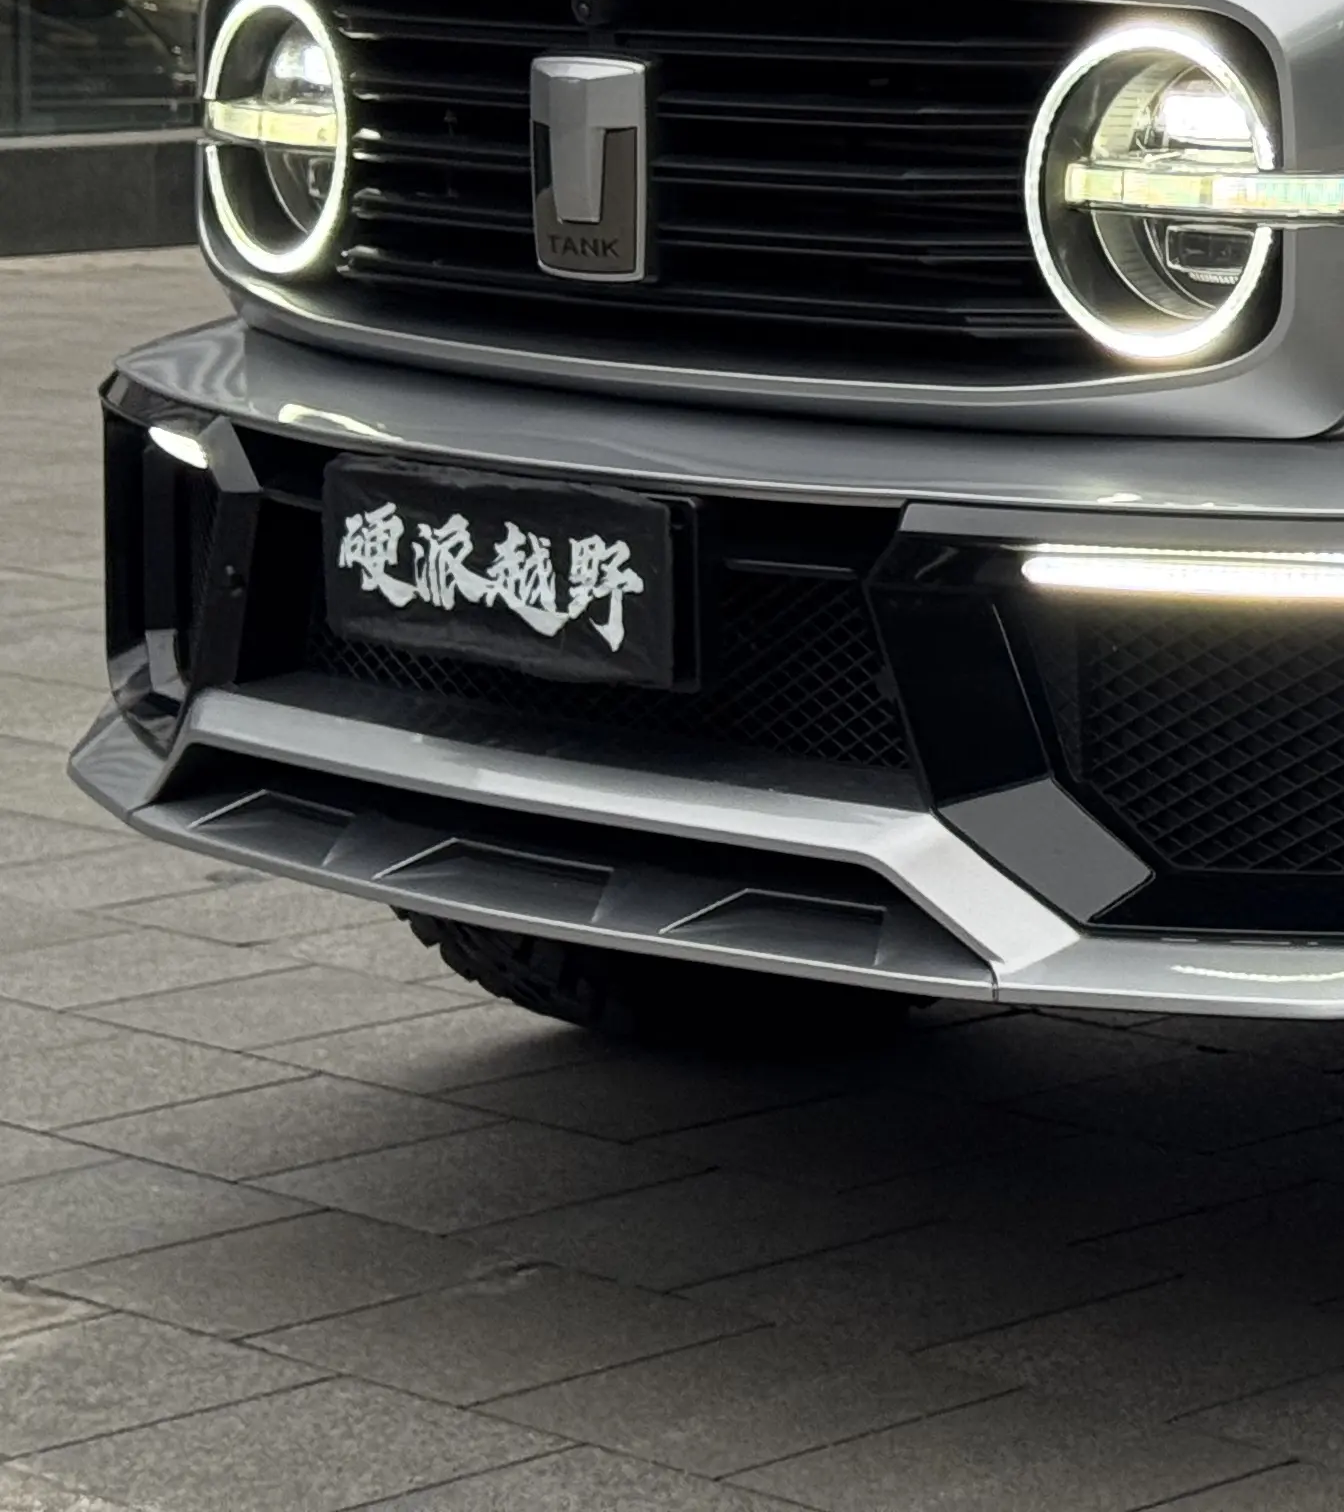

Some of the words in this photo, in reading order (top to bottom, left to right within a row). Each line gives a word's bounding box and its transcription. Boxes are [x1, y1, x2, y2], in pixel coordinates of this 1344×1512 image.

[547, 234, 620, 258] TANK
[338, 502, 644, 653] 硬派越野
